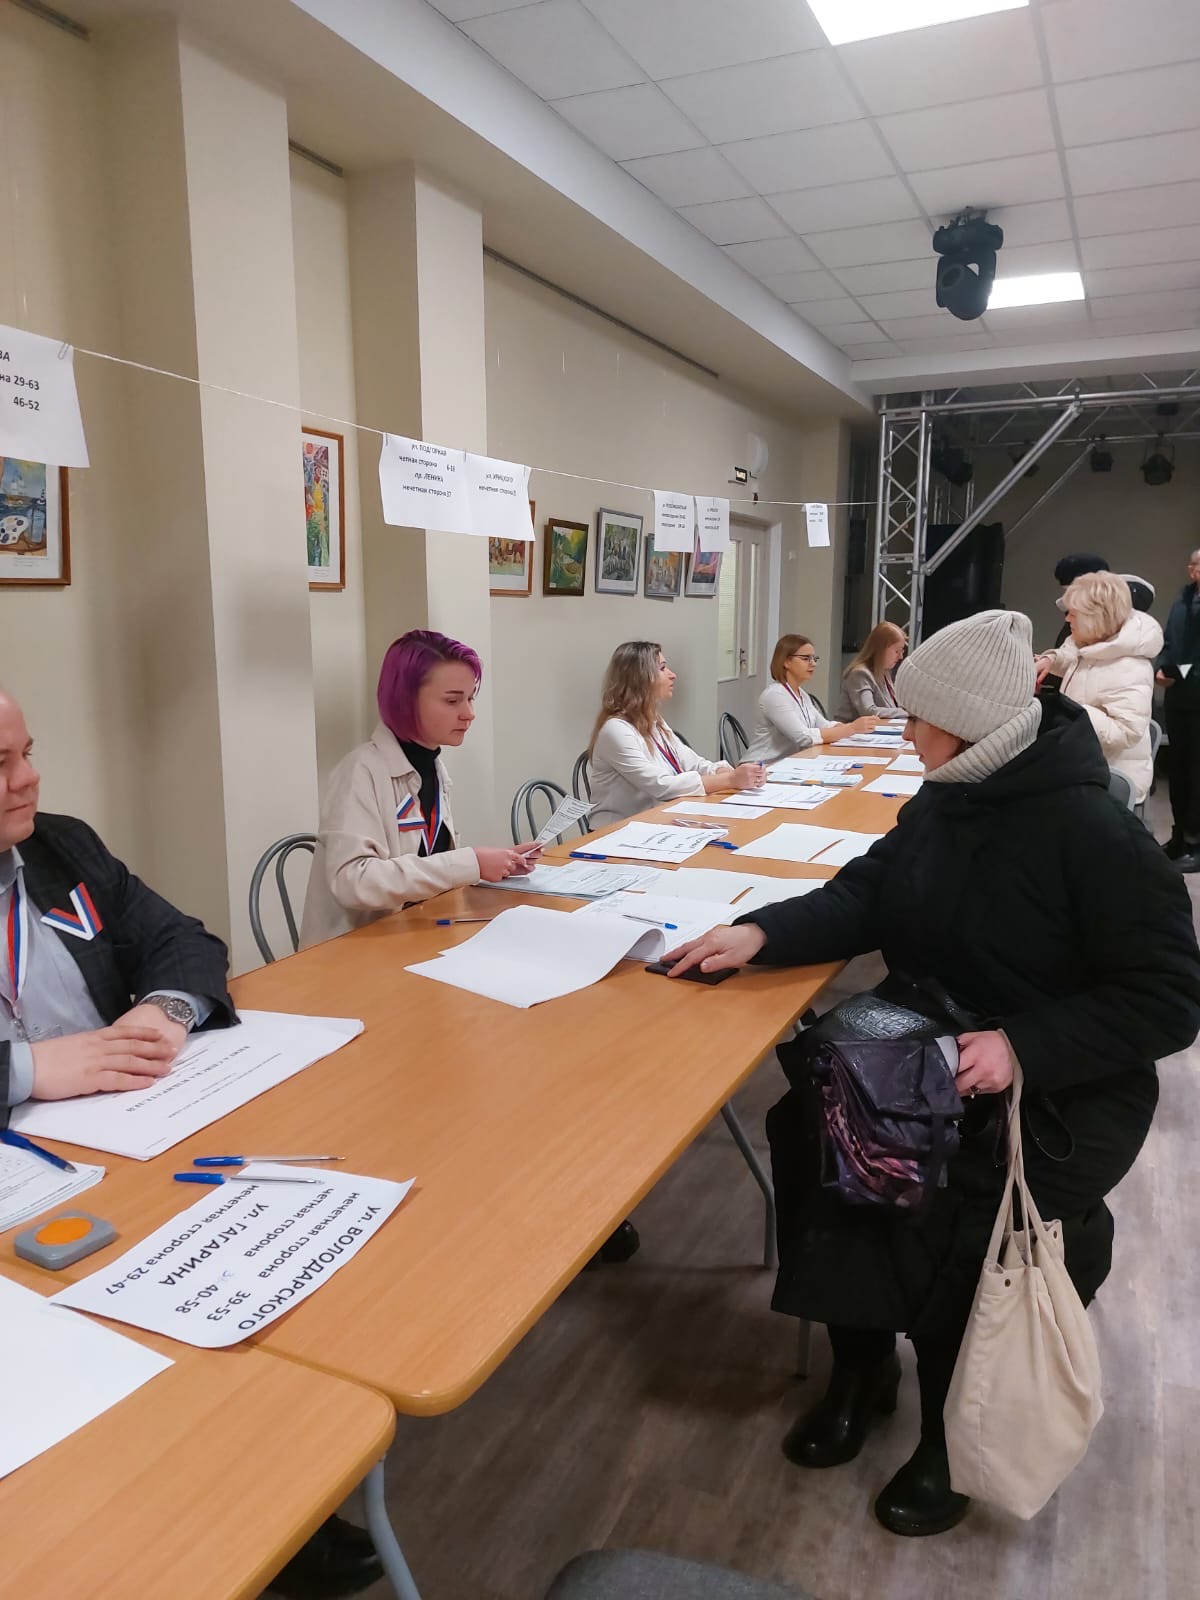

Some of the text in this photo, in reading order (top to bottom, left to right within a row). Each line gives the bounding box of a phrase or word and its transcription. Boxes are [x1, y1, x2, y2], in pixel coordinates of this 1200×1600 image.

[13, 375, 40, 391] 29-63
[13, 396, 40, 411] 46-52
[105, 1185, 260, 1295] нечетная сторона 29-47
[158, 1203, 270, 1287] ул. ГАГАРИНА
[175, 1188, 335, 1314] четная сторона 40-58
[206, 1192, 361, 1321] нечетная сторона 39-53
[238, 1205, 382, 1330] ул. ВОЛОДАРСКОГО
